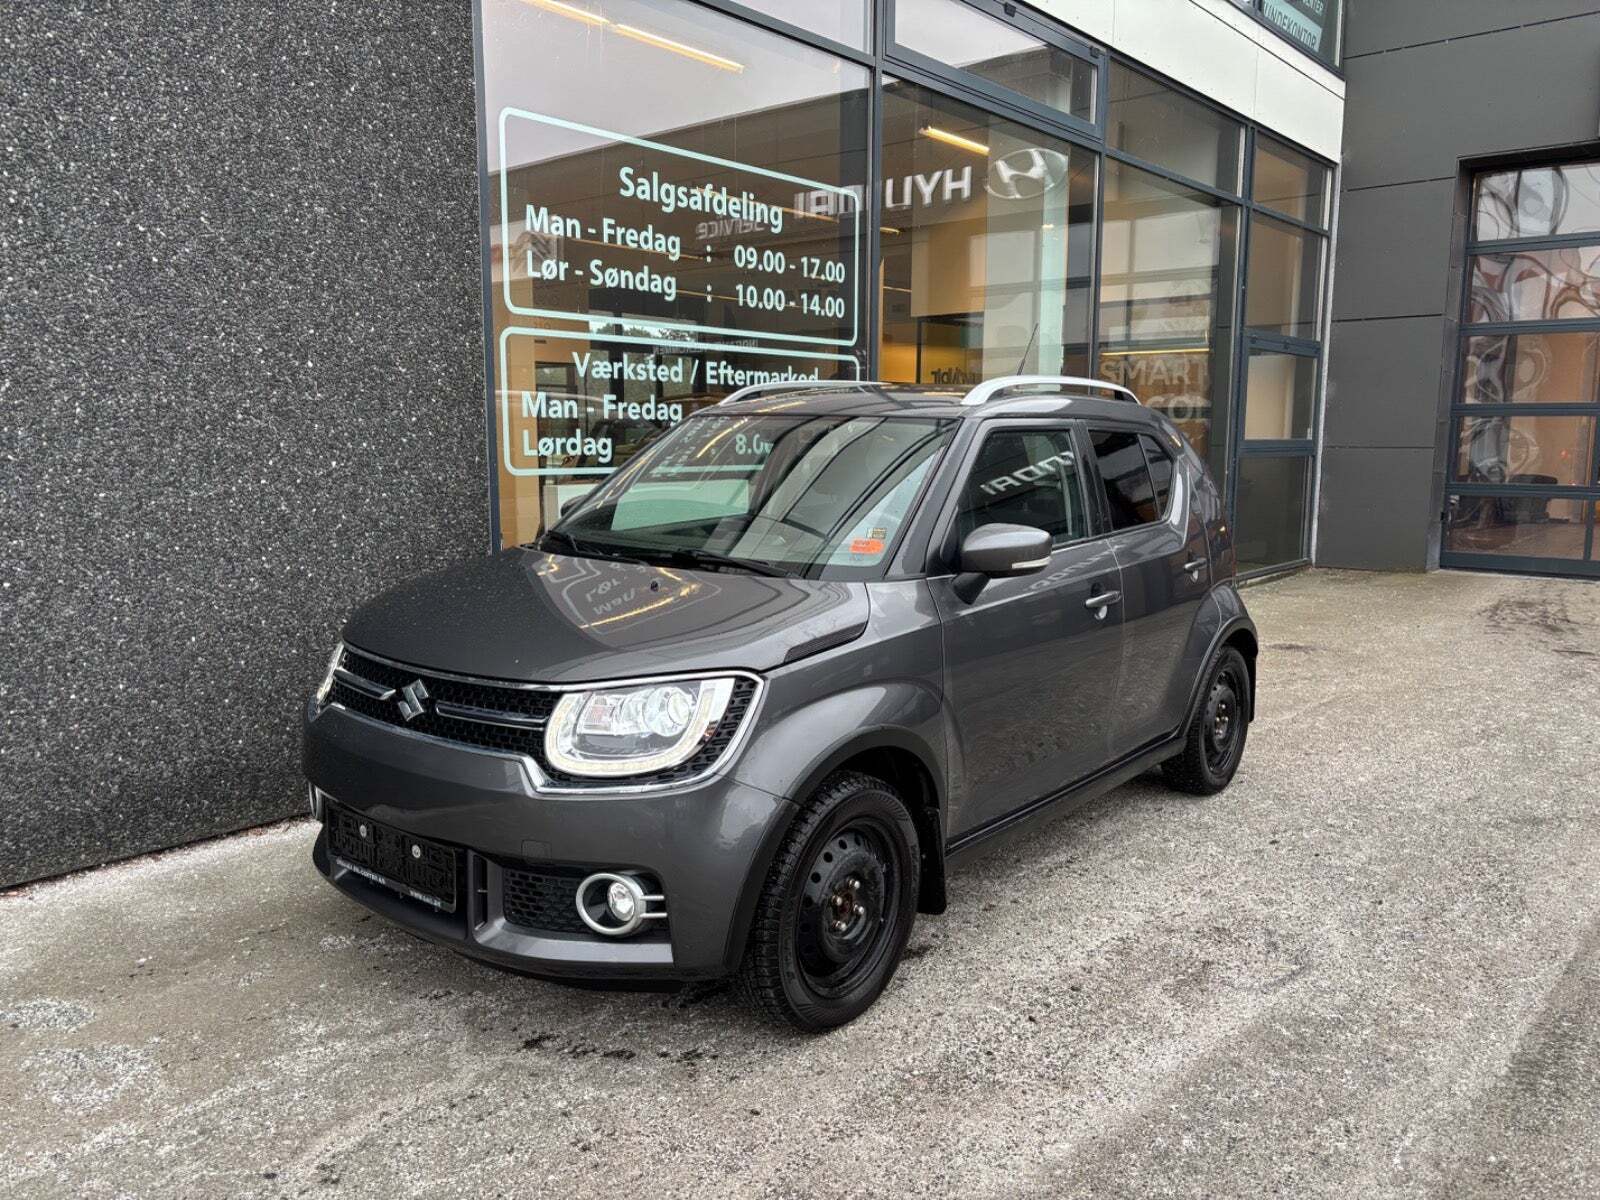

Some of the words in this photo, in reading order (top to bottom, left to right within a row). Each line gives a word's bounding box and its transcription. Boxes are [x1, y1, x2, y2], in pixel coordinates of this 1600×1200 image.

[619, 166, 783, 233] Salgsafdeling
[525, 204, 581, 239] Man
[602, 217, 681, 262] Fredag
[734, 245, 785, 274] 09.00
[801, 256, 845, 284] 17.00
[527, 250, 569, 282] Lør
[590, 258, 677, 301] Søndag
[735, 283, 785, 311] 10.00
[801, 292, 845, 318] 14.00
[572, 352, 683, 384] Værksted
[689, 359, 699, 385] /
[706, 361, 819, 386] Eftermarked
[521, 391, 578, 420] Man
[602, 394, 683, 428] Fredag
[522, 429, 613, 464] Lørdag
